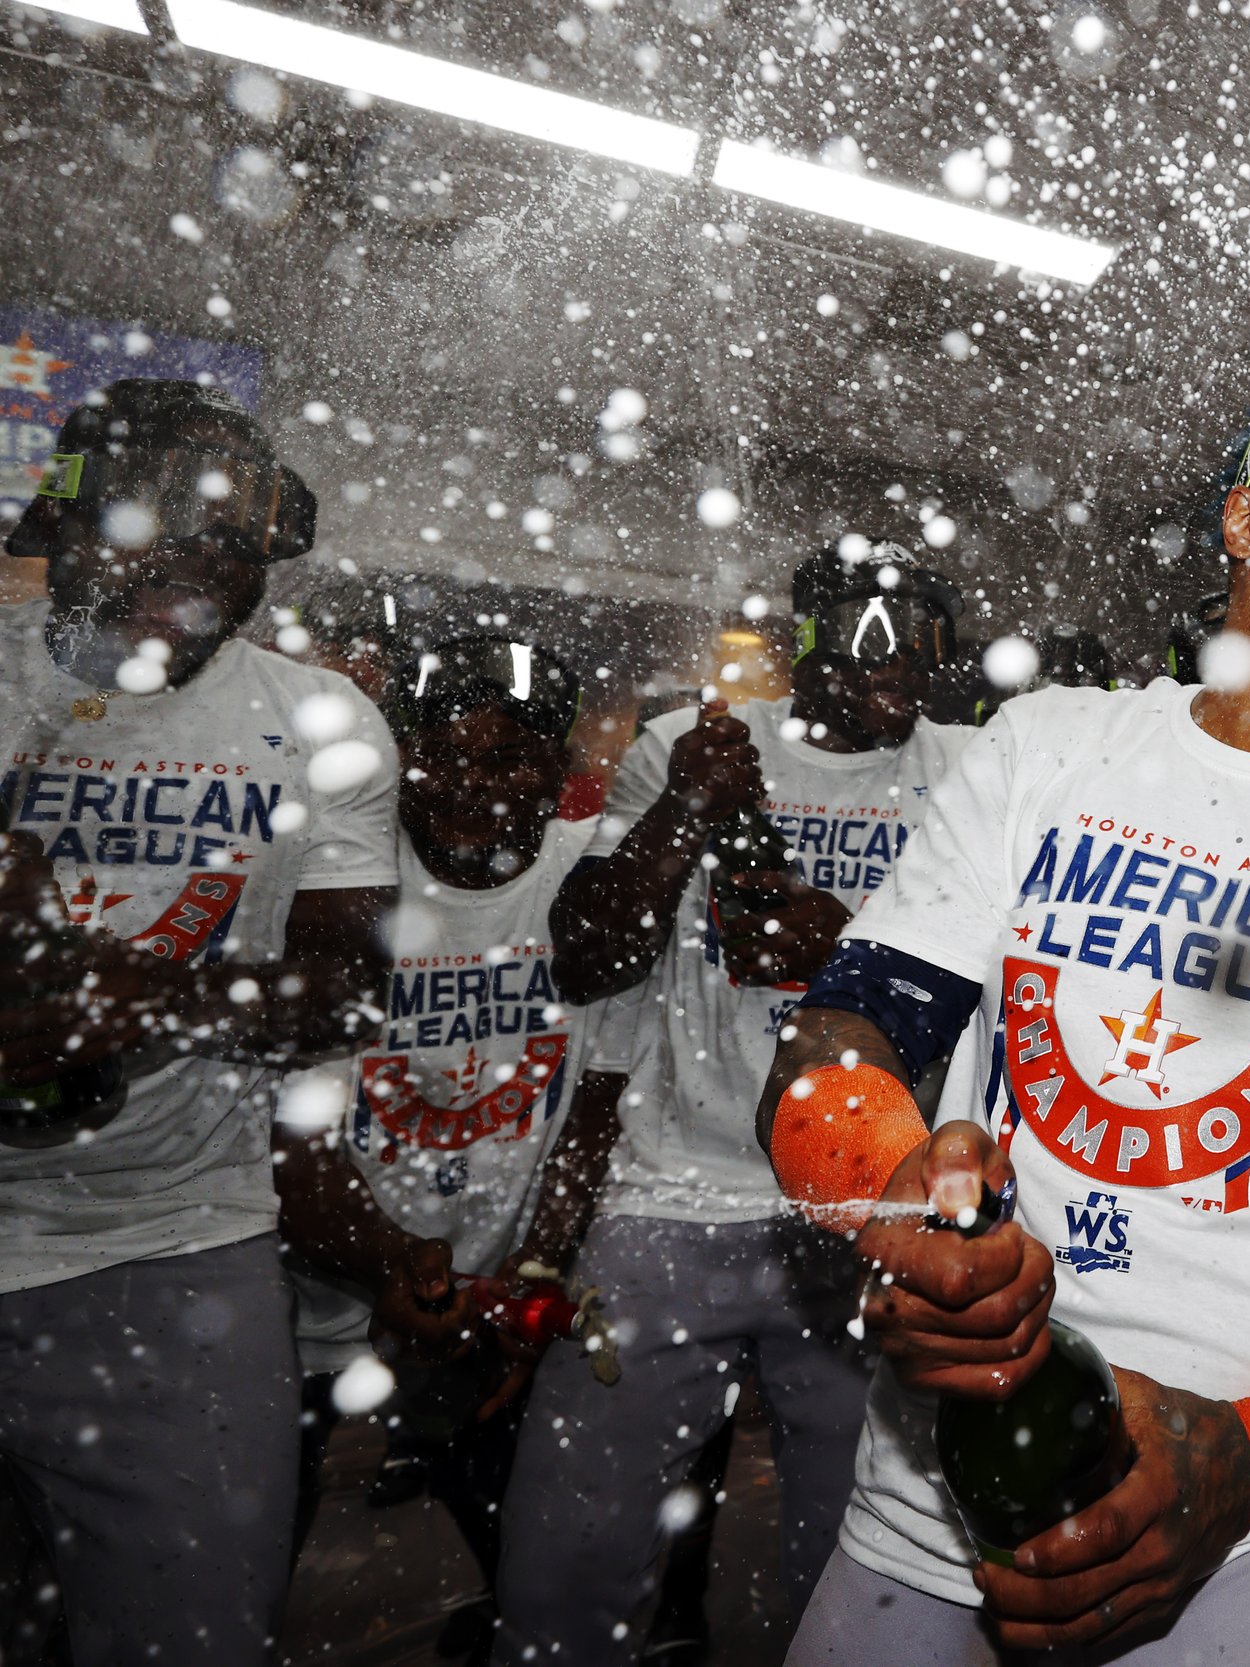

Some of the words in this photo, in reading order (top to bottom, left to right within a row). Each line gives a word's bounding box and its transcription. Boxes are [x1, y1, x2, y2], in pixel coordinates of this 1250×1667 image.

[46, 827, 227, 867] AGUE
[1077, 813, 1221, 867] HOUSTON
[388, 1005, 549, 1051] LEAGUE
[1103, 1009, 1181, 1084] H
[1064, 1205, 1129, 1253] WS
